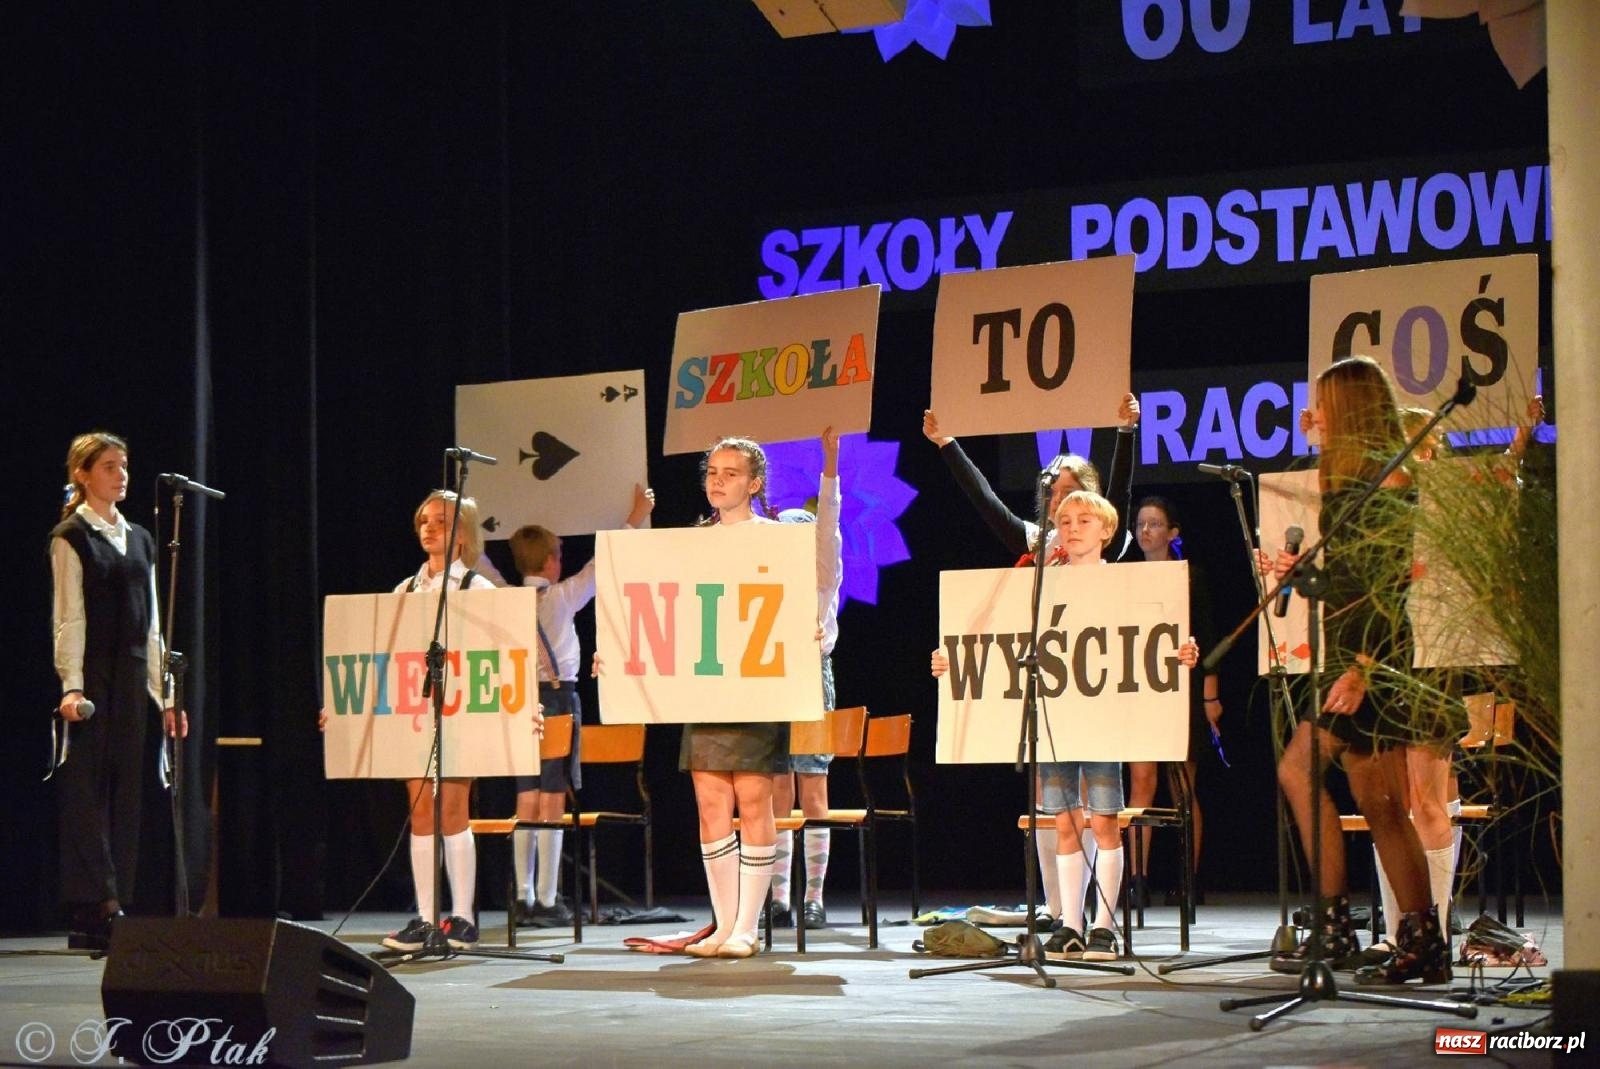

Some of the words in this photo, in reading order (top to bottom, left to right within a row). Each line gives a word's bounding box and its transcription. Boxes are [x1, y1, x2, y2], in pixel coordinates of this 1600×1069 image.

[1293, 0, 1422, 45] LA
[758, 211, 1014, 300] SZKOŁY
[674, 333, 872, 410] SZKOŁA
[972, 302, 1076, 395] TO
[1331, 274, 1509, 396] COŚ
[623, 384, 639, 402] A
[623, 565, 786, 678] NIŻ
[943, 603, 1180, 701] WYŚCIG
[325, 649, 529, 733] WIĘCEJ
